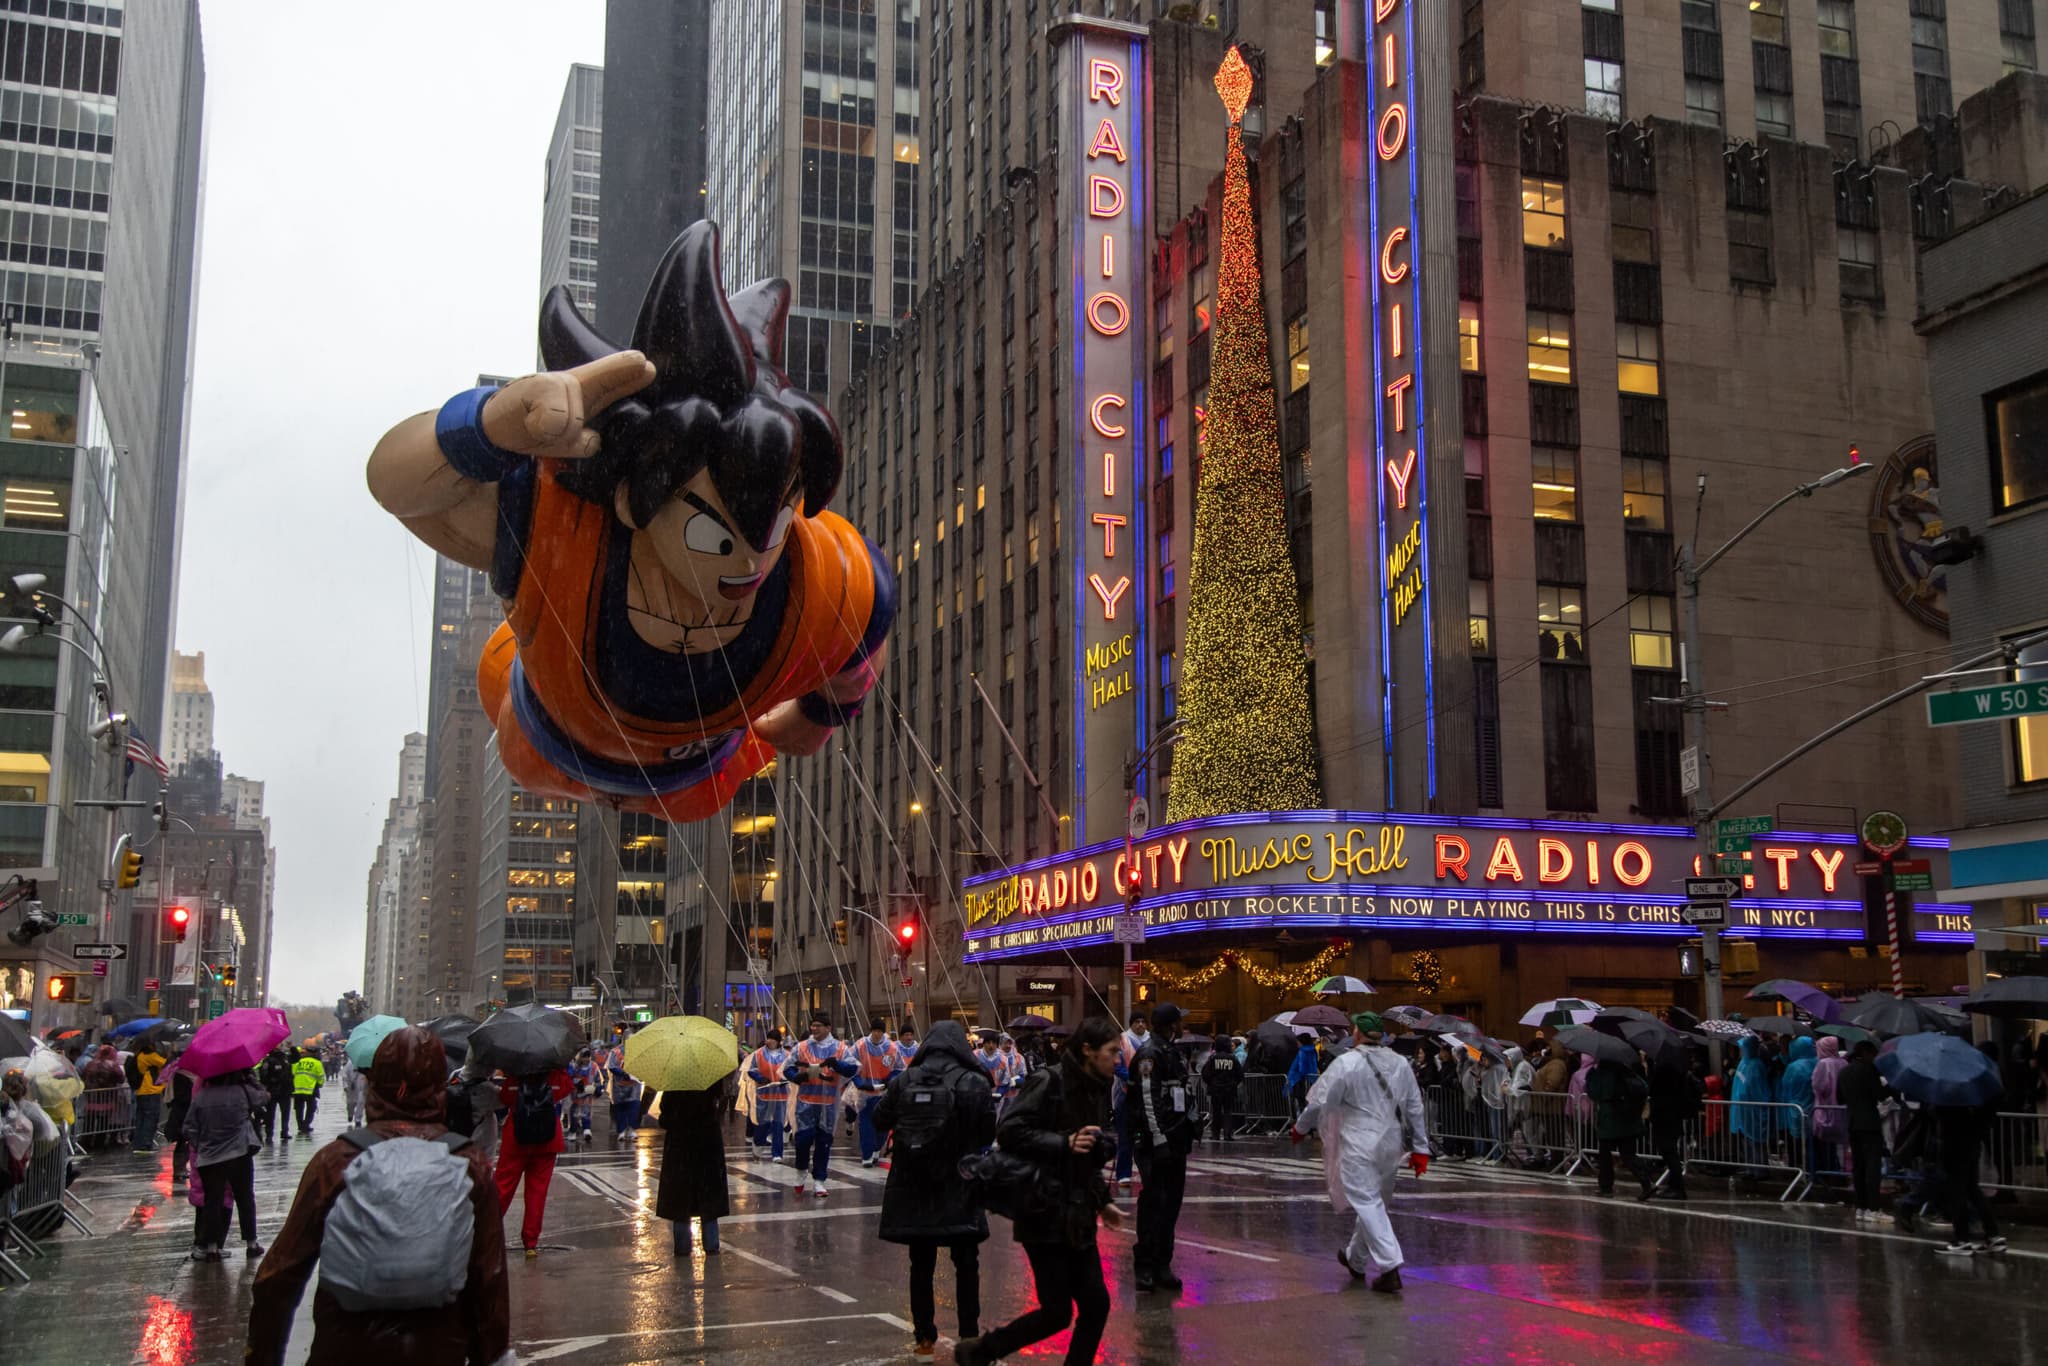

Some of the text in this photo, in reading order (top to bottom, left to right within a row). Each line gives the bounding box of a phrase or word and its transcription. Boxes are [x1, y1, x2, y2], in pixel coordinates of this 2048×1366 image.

[1087, 58, 1130, 620] RADIO CITY
[1381, 226, 1416, 509] CITY
[1974, 693, 1991, 713] W
[2001, 689, 2028, 711] 50
[1721, 821, 1769, 834] AMERICAS
[1725, 838, 1734, 851] 6
[1201, 825, 1409, 884] Music Hall
[1435, 834, 1653, 887] RADIO
[1731, 860, 1743, 873] 50
[1021, 862, 1098, 915] RADIO
[1692, 884, 1734, 893] ONE WAY
[63, 914, 78, 924] 50
[1685, 909, 1718, 919] ONE WAY
[990, 936, 1001, 949] THE
[1003, 929, 1039, 948] CHRISTMAS
[1042, 920, 1093, 942] SPECTACULAR
[1159, 903, 1188, 924] RADIO
[1195, 899, 1232, 919] CITY
[1246, 896, 1376, 915] ROCKETTES
[1390, 898, 1433, 916] NOW
[1447, 900, 1531, 918] PLAYING
[1544, 902, 1586, 920] THIS
[1599, 904, 1616, 922] IS
[1744, 908, 1761, 926] IN
[1771, 909, 1815, 926] NYC!
[1936, 914, 1972, 931] THIS
[1029, 982, 1056, 991] Subway
[1214, 1058, 1233, 1070] NYPD
